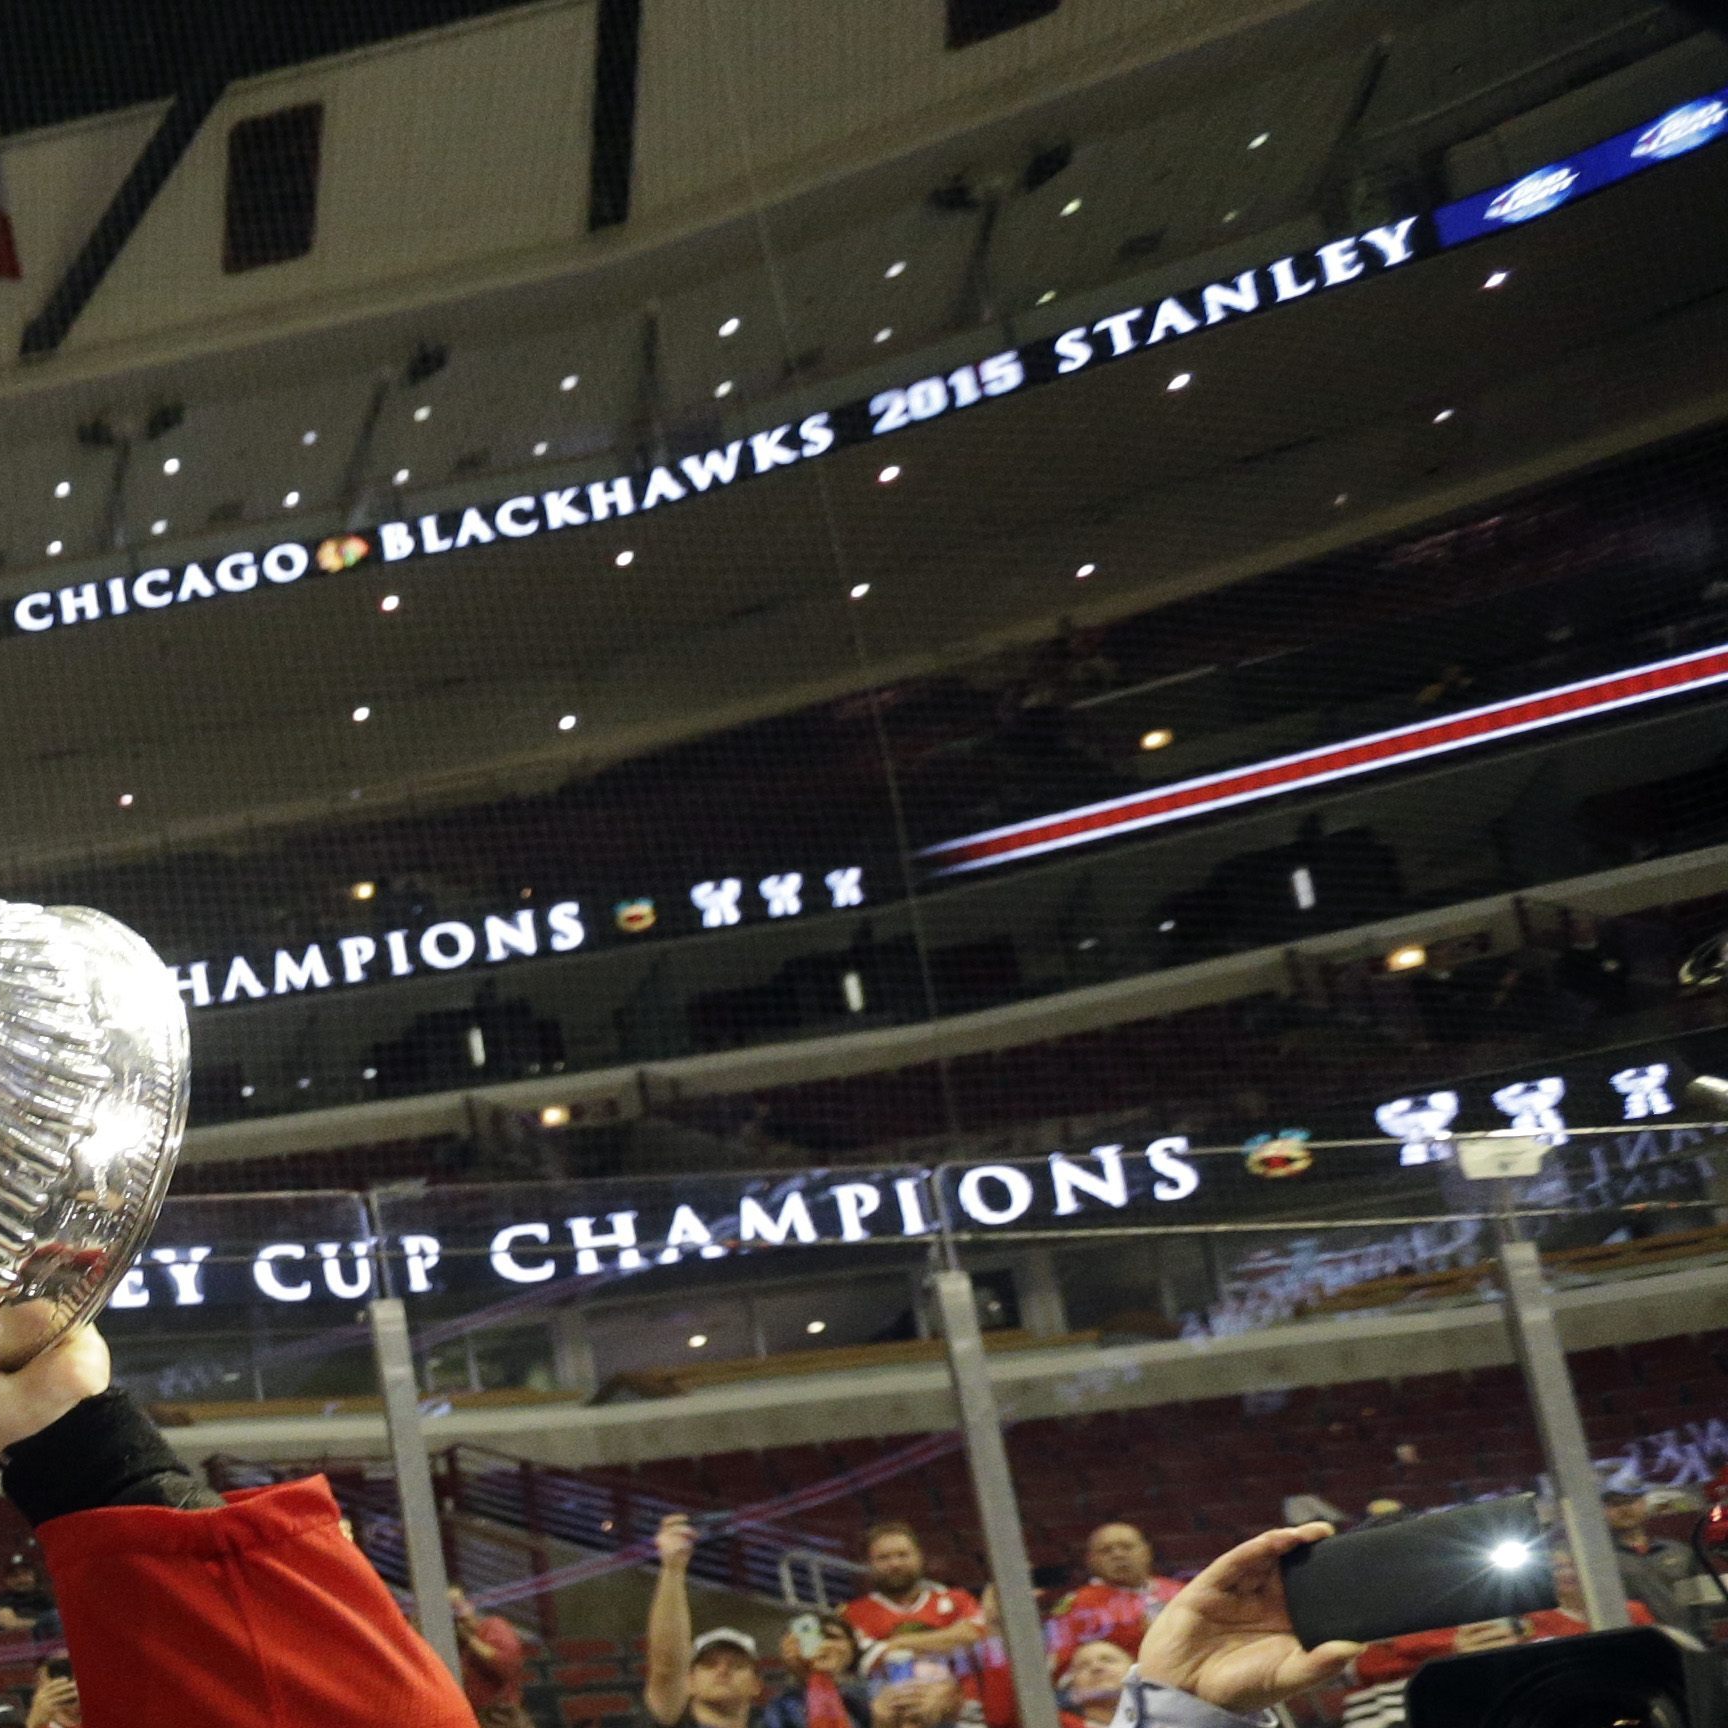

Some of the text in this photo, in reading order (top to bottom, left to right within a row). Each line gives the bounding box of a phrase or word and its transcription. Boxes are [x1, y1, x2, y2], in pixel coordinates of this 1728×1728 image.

[13, 216, 1418, 632] CHICAGO BLACKHAWKS 2015 STANLEY
[174, 900, 586, 1008] HAMPIONS
[251, 1234, 442, 1303] CUP
[489, 1134, 1202, 1285] CHAMPIONS
